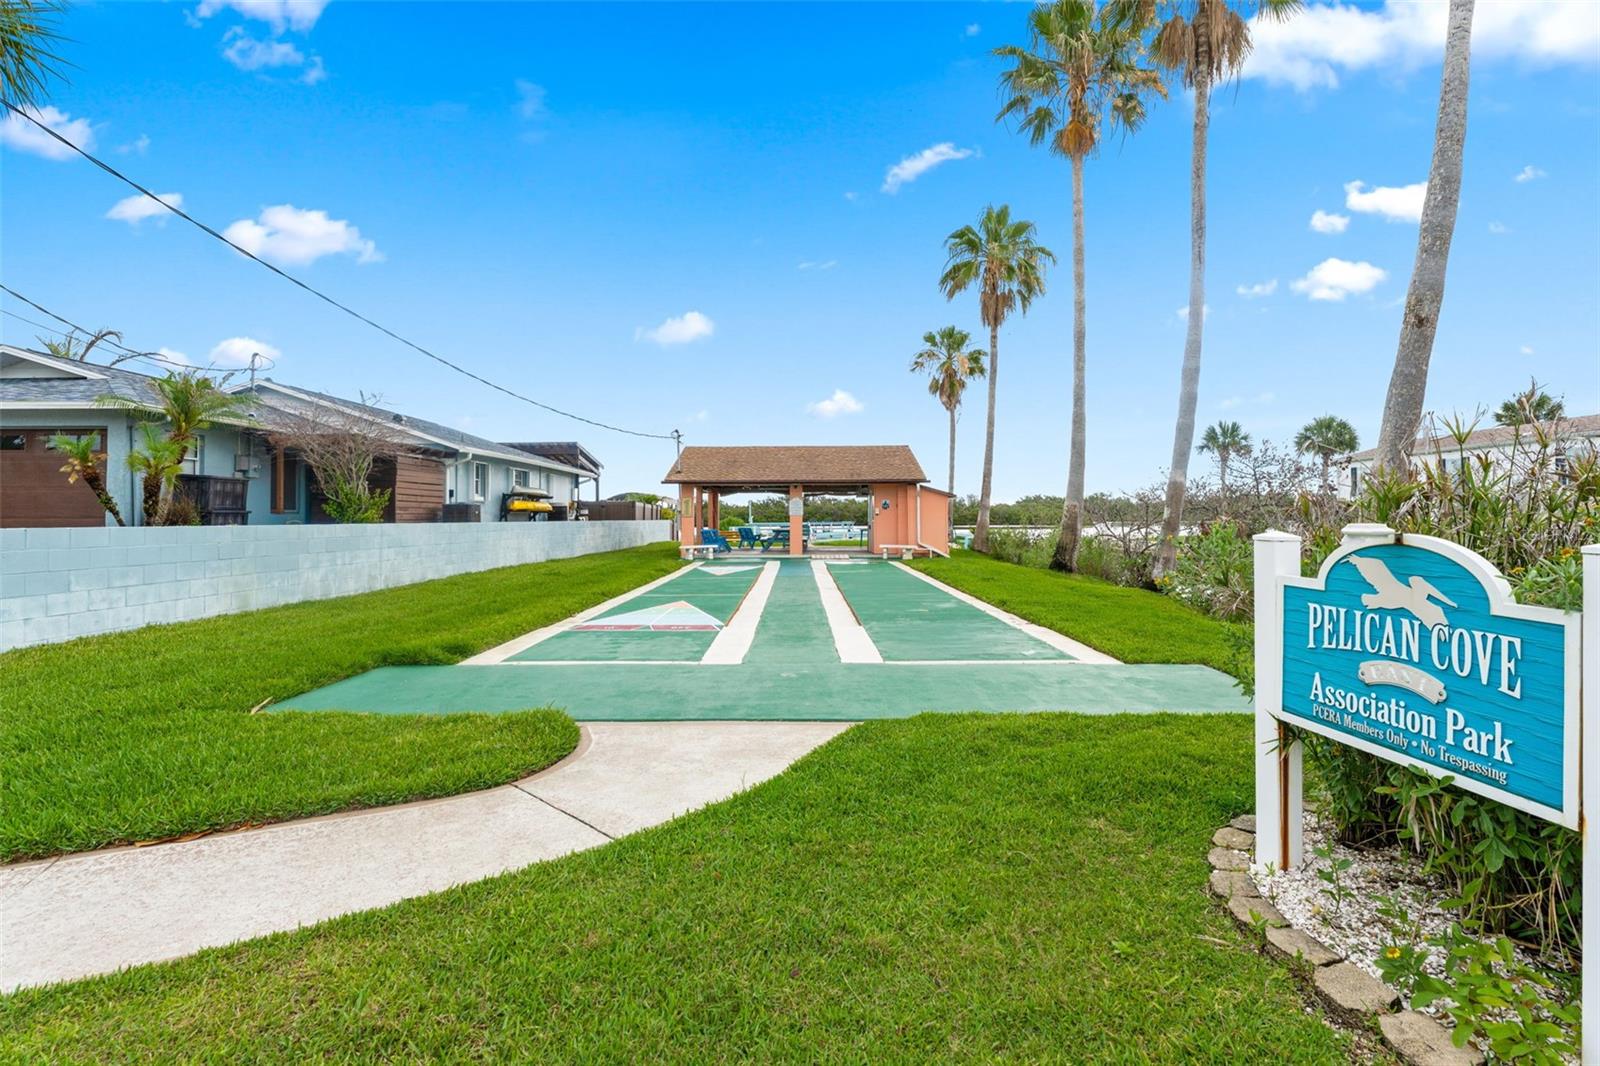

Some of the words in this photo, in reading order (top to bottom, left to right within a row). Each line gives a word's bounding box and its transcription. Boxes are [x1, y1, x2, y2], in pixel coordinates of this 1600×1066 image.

[1307, 602, 1421, 663] PELICAN
[1430, 623, 1522, 699] COVE
[1309, 671, 1437, 740] Association
[1445, 707, 1513, 765] Park
[1312, 703, 1342, 725] PCERA
[1343, 713, 1385, 740] Members
[1386, 728, 1409, 750] Only
[1420, 739, 1436, 758] No
[1438, 744, 1508, 785] Trespassing
